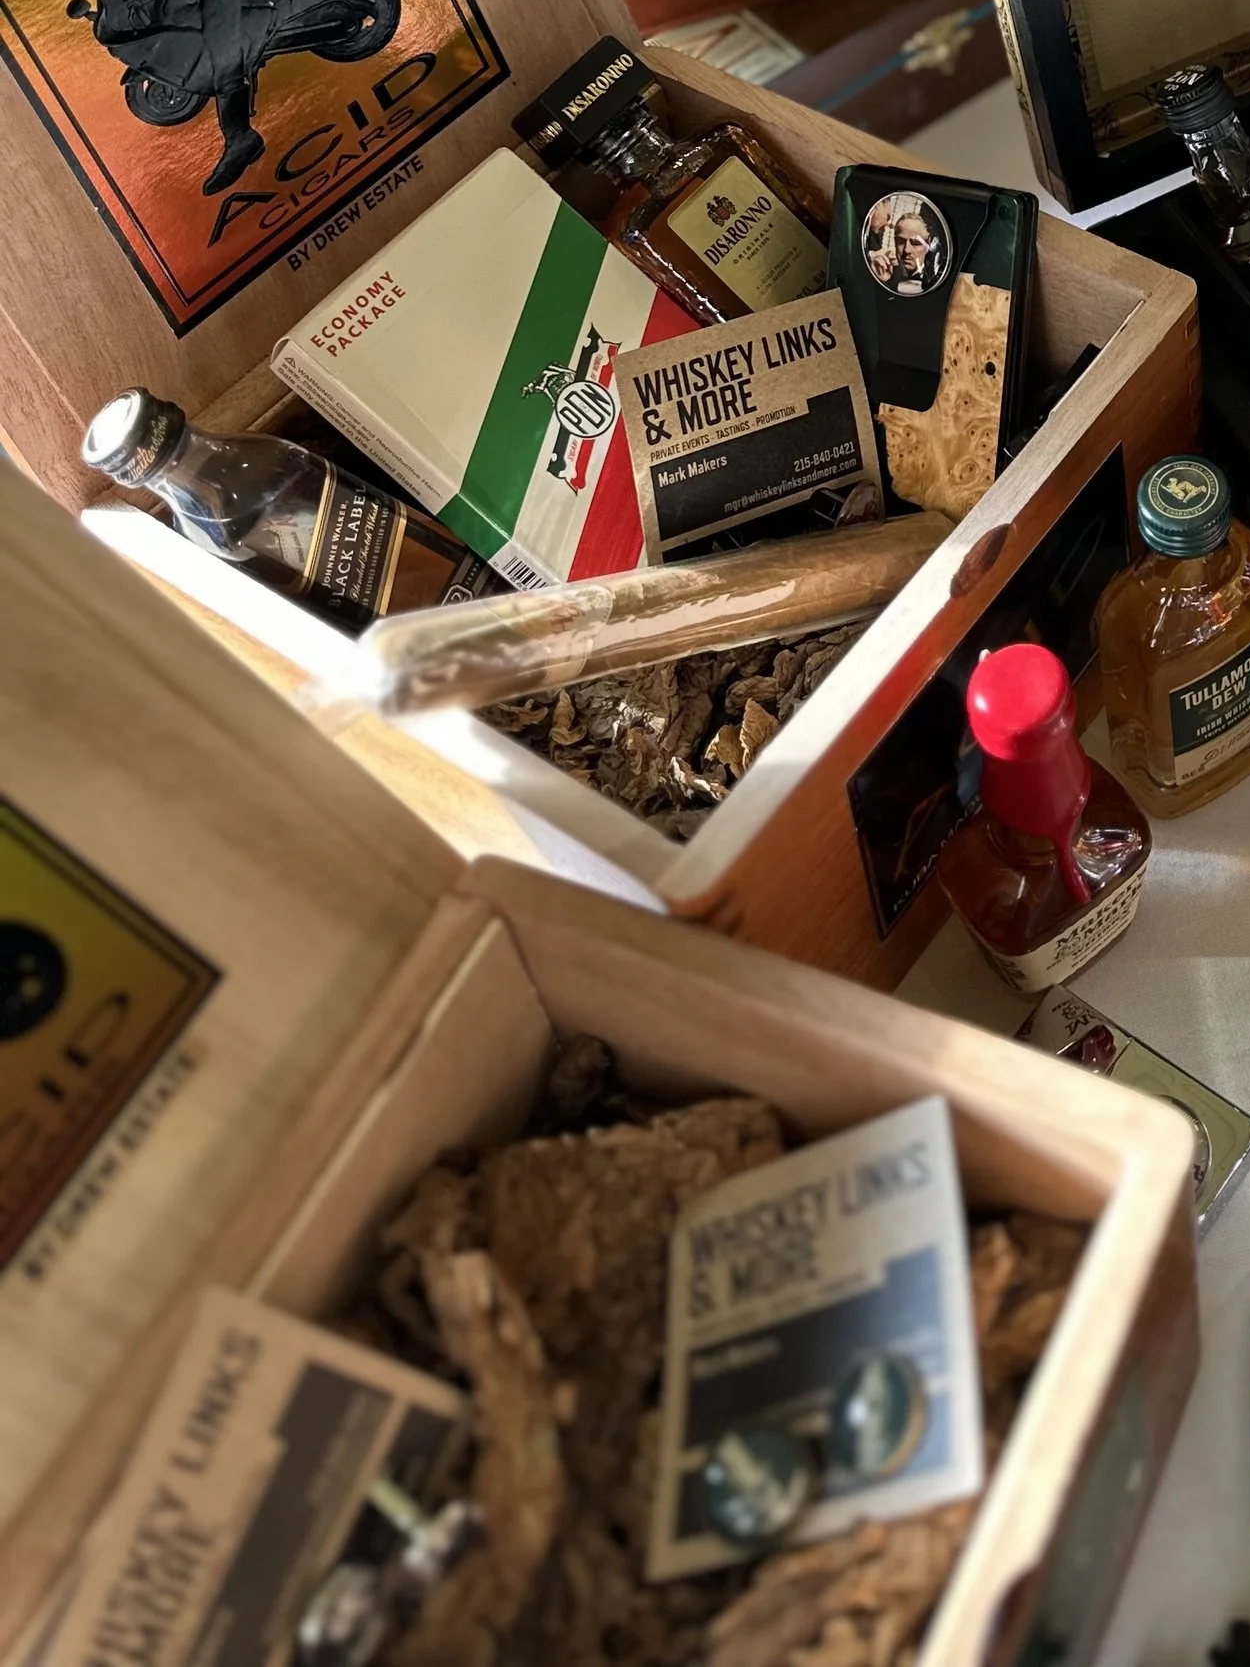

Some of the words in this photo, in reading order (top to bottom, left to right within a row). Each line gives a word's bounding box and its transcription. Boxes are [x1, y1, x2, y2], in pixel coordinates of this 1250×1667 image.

[561, 53, 634, 122] DISARONNO
[208, 52, 437, 249] ACID
[259, 105, 416, 230] CIGARS
[287, 246, 311, 272] BY
[312, 201, 361, 252] DREW
[363, 154, 425, 211] ESTATE
[704, 195, 773, 266] DISARONNO
[733, 222, 775, 265] ORIGINALE
[310, 270, 396, 348] ECONOMY
[326, 285, 407, 358] PACKAGE
[632, 340, 755, 409] WHISKEY
[761, 317, 838, 370] LINKS
[277, 367, 296, 386] Sale
[296, 384, 314, 401] only
[355, 435, 369, 449] the
[369, 447, 396, 473] United
[396, 471, 422, 497] States
[642, 408, 673, 446] &
[676, 379, 758, 437] MORE
[650, 445, 682, 463] PRIVATE
[681, 434, 710, 452] EVENTS
[715, 422, 751, 441] TASTINGS
[756, 405, 796, 427] PROMOTION
[658, 469, 687, 488] Mark
[687, 454, 728, 479] Makers
[723, 456, 858, 514] mgr@whiskeylinksandmore.com
[794, 441, 856, 473] 215-840-0421
[322, 540, 339, 590] JOHNNIE
[328, 549, 355, 608] BLACK
[345, 483, 368, 543] LABEL
[1196, 716, 1222, 737] IRISH
[1212, 675, 1247, 711] DEW
[690, 1179, 827, 1266] WHISKEY
[836, 1138, 933, 1220] LINKS
[167, 1325, 263, 1474] LINKS
